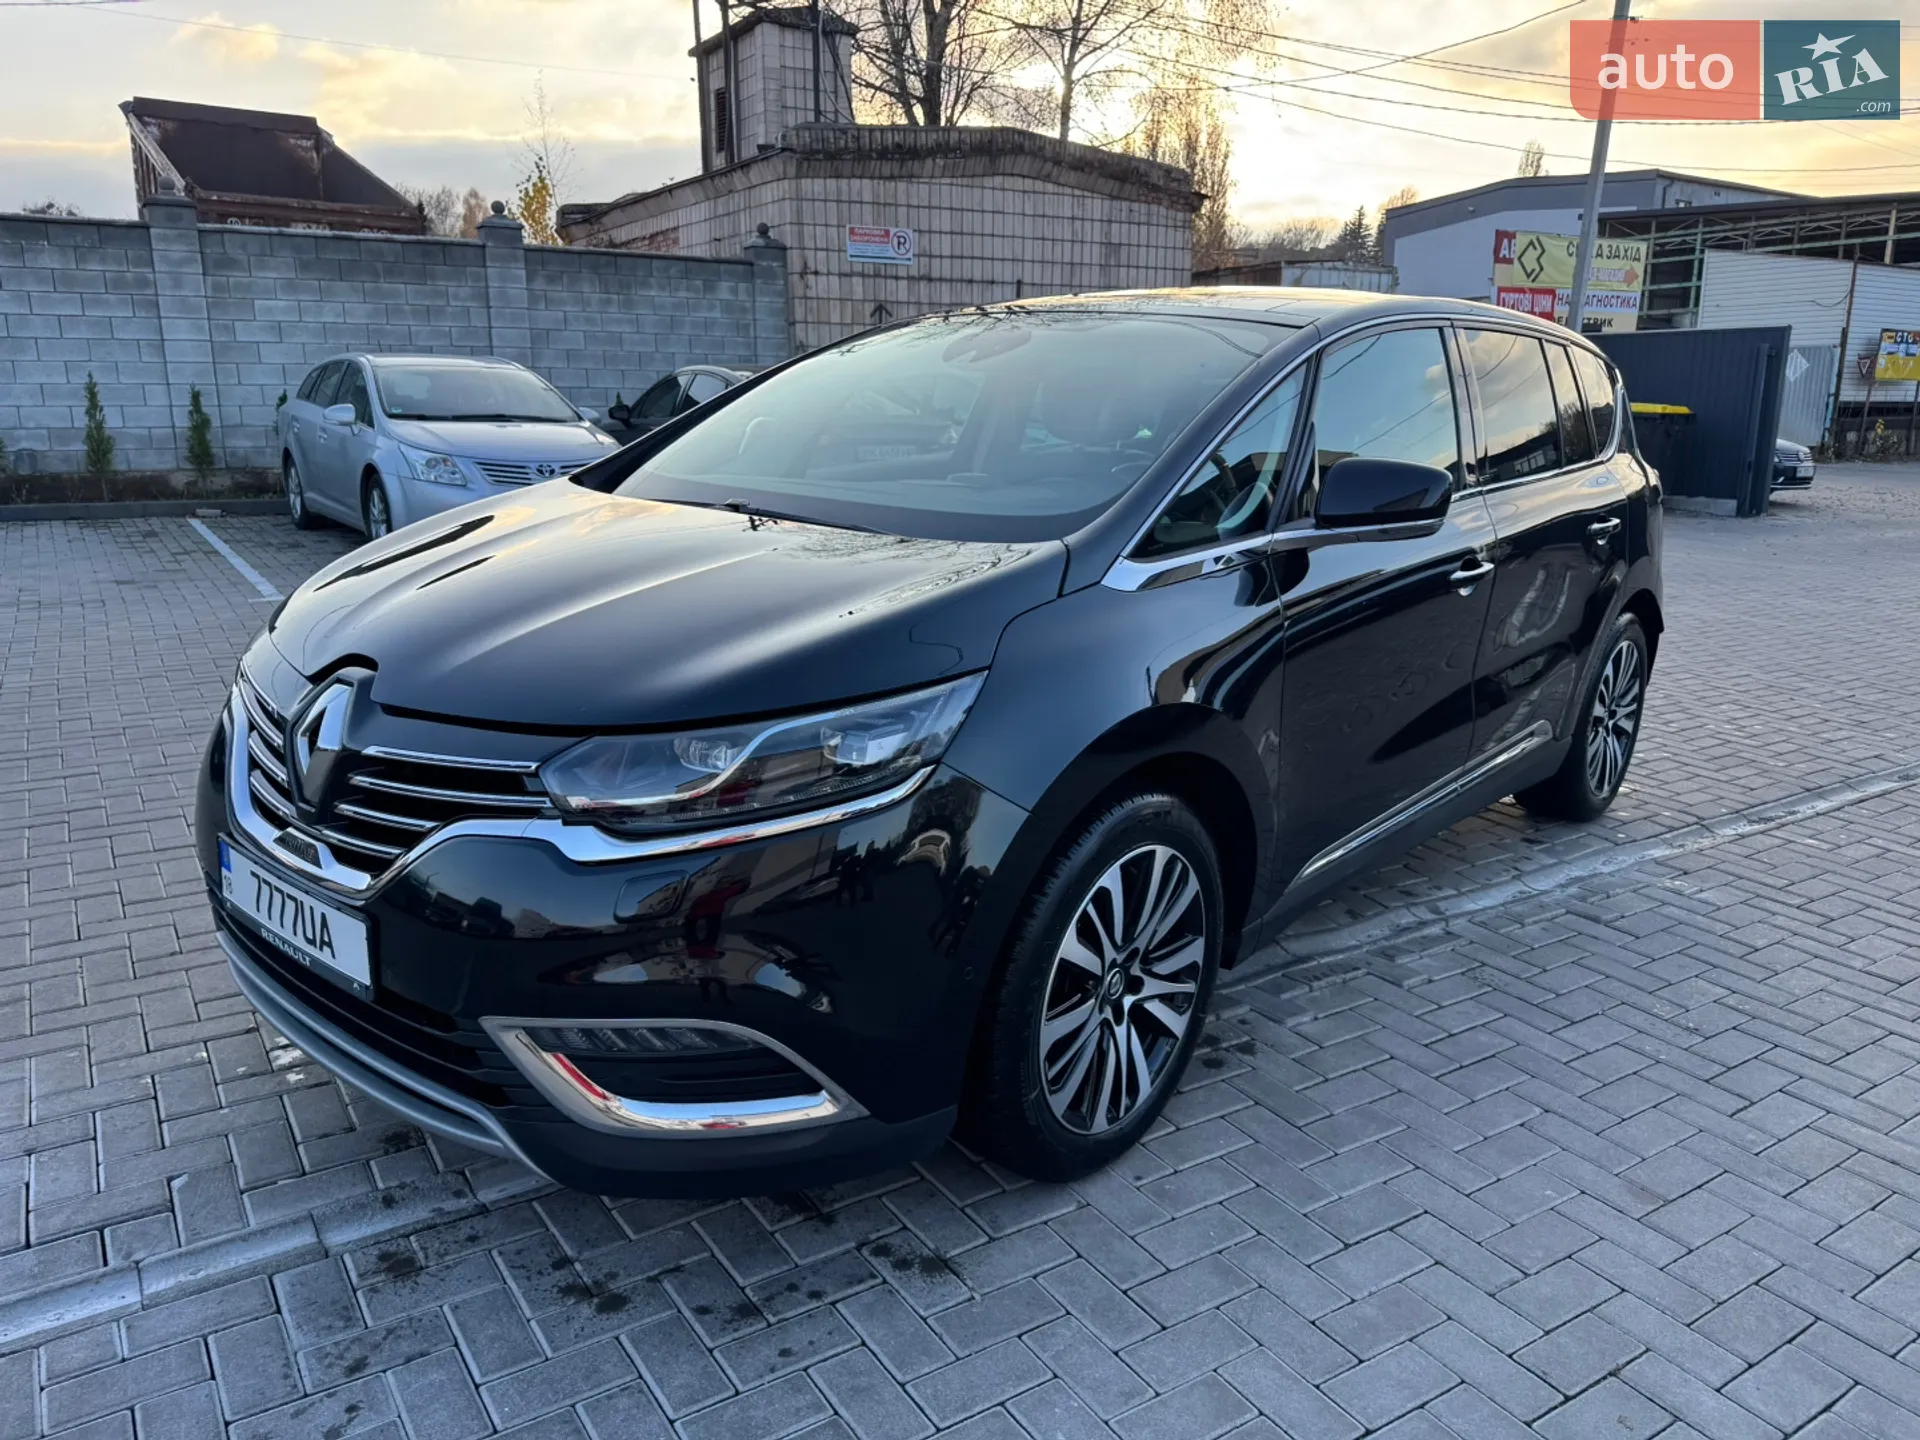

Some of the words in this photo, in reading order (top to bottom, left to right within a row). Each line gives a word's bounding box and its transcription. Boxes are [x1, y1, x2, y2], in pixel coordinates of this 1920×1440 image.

[1606, 243, 1641, 262] ЗАХІД
[250, 869, 336, 960] 7777UA
[261, 928, 311, 967] RENAULT
